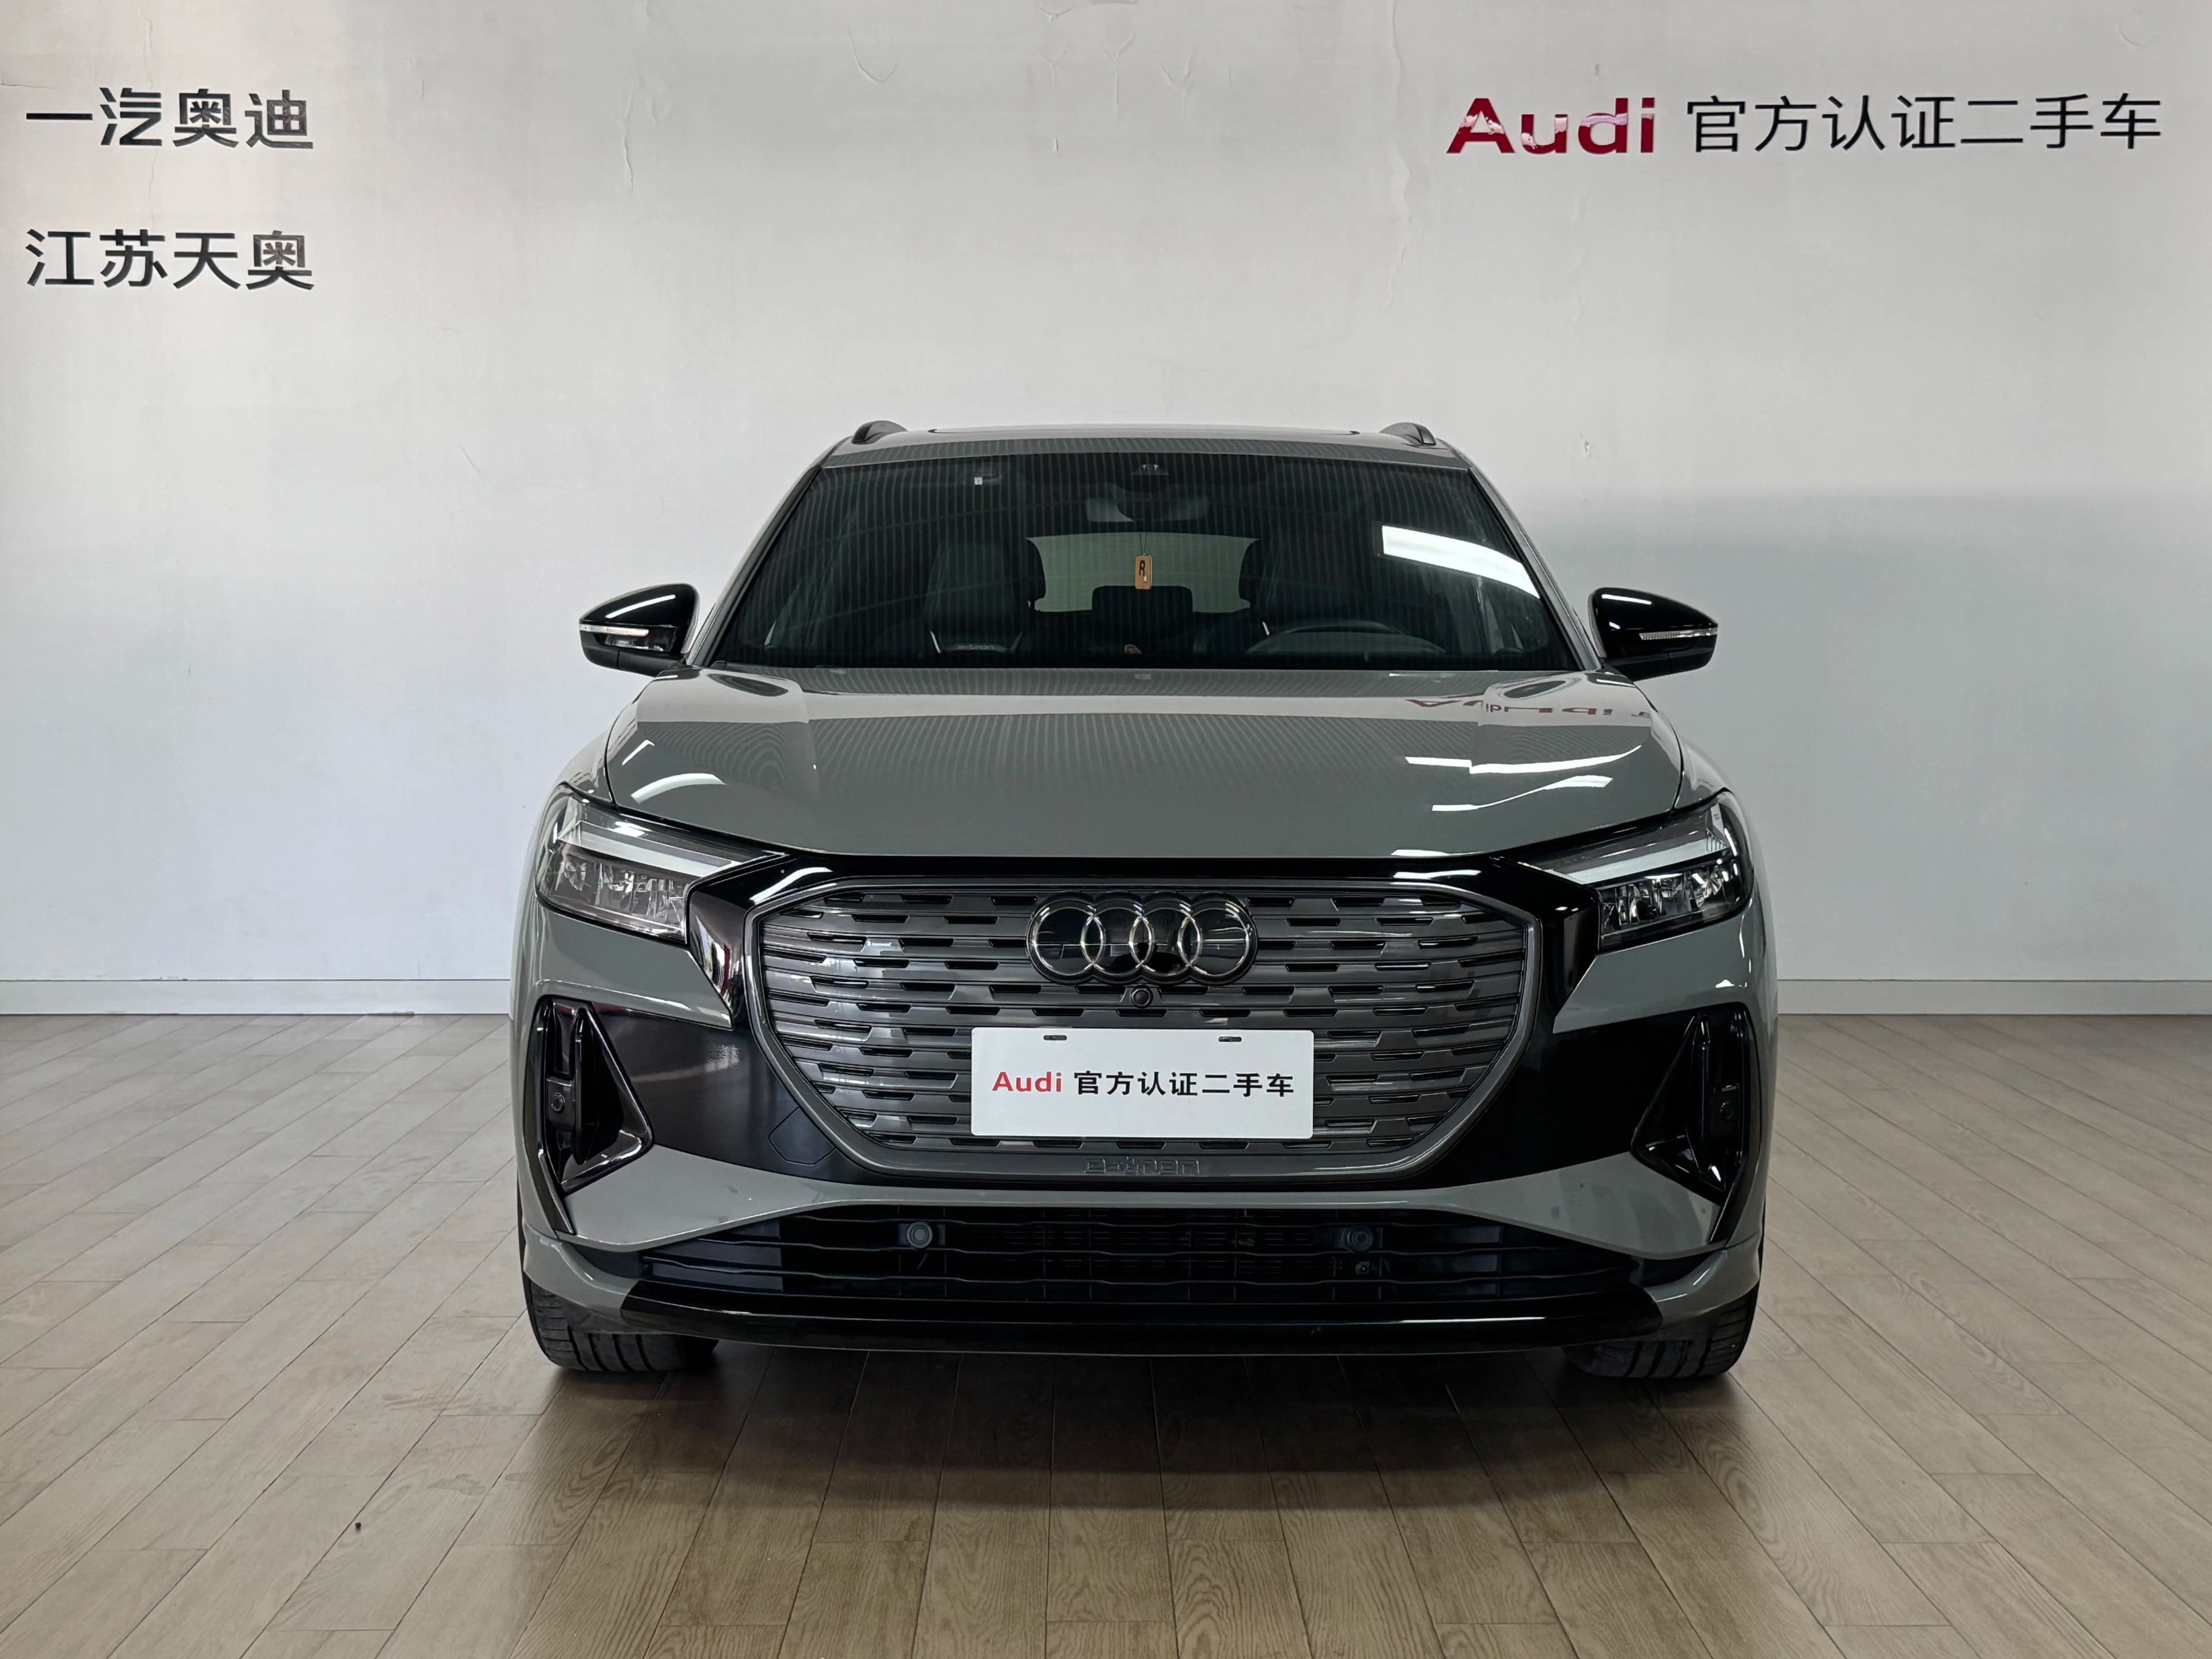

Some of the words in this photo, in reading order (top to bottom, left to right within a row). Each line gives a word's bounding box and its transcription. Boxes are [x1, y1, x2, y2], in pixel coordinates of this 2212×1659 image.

[26, 87, 313, 149] 一汽奥迪
[1446, 97, 1655, 154] Audi
[1686, 93, 2161, 153] 官方认证二手车
[25, 229, 315, 290] 江苏天奥
[992, 1071, 1062, 1093] Audi
[1074, 1070, 1294, 1097] 官方认证二手车
